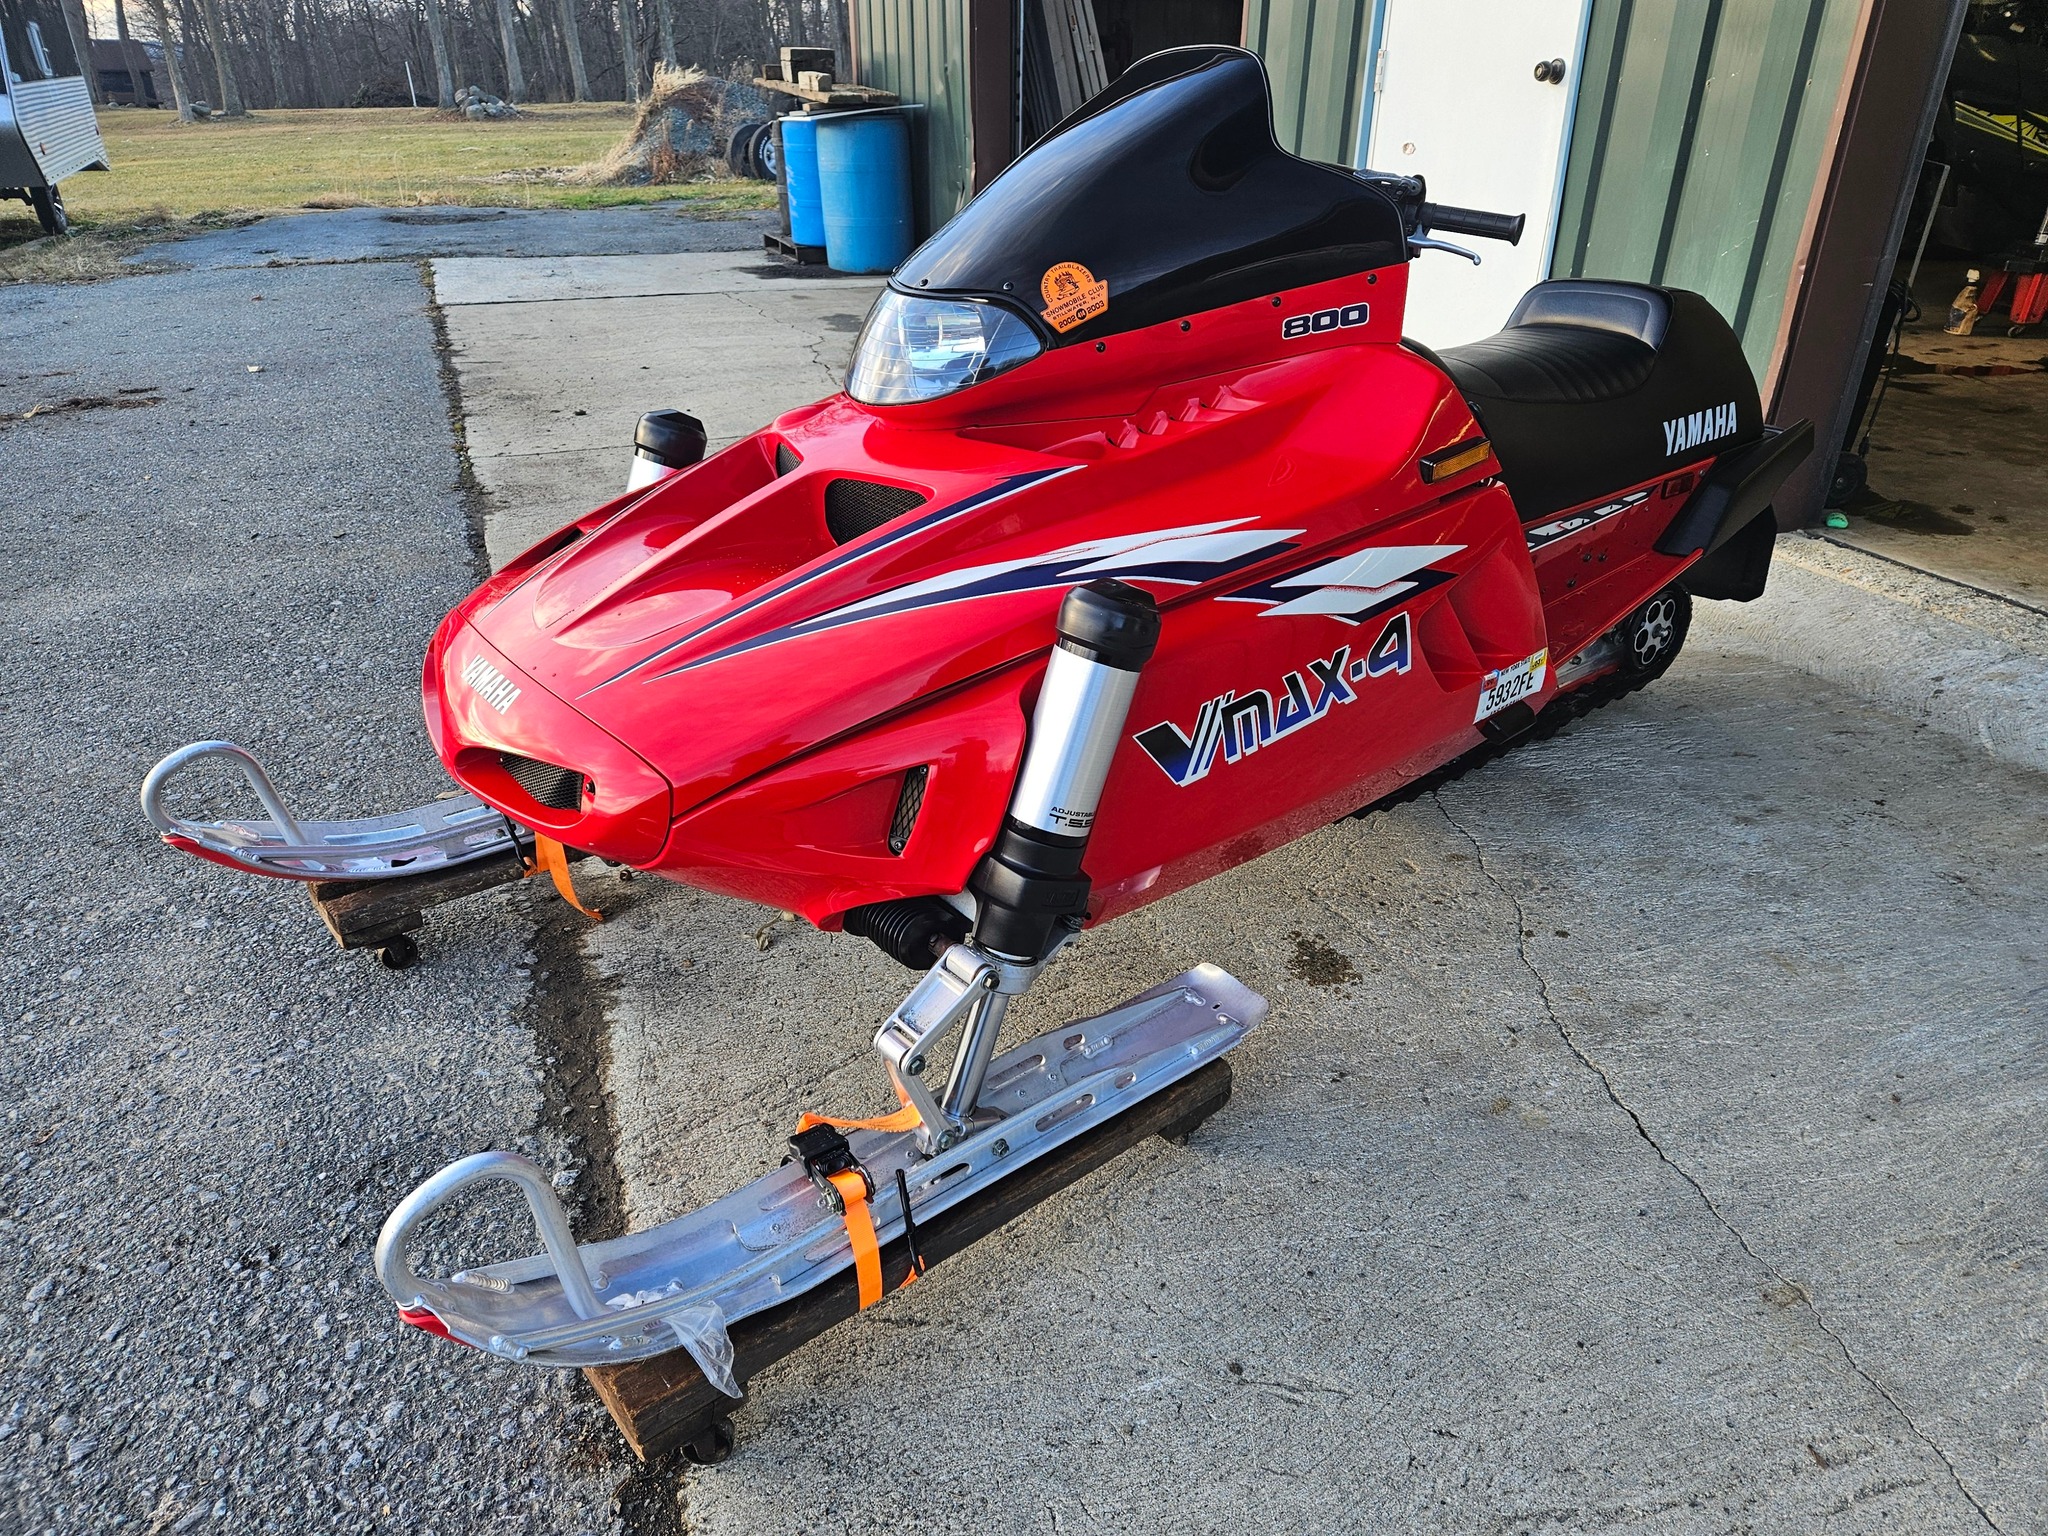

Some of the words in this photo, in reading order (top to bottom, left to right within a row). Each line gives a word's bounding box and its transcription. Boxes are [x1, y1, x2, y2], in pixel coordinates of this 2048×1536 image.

[1044, 274, 1053, 303] COUNTRY
[1050, 264, 1092, 283] TRAILBLAZERS
[1046, 293, 1086, 317] SNOWMOBILE
[1088, 284, 1104, 296] CLUB
[1052, 300, 1090, 320] STILLWATER,
[1090, 293, 1103, 301] N.Y.
[1058, 315, 1077, 328] 2002
[1086, 300, 1105, 314] 2003
[1282, 302, 1370, 340] 800
[1662, 401, 1737, 457] YAMAHA
[460, 654, 522, 716] YAMAHA
[1486, 671, 1534, 711] 5932FE
